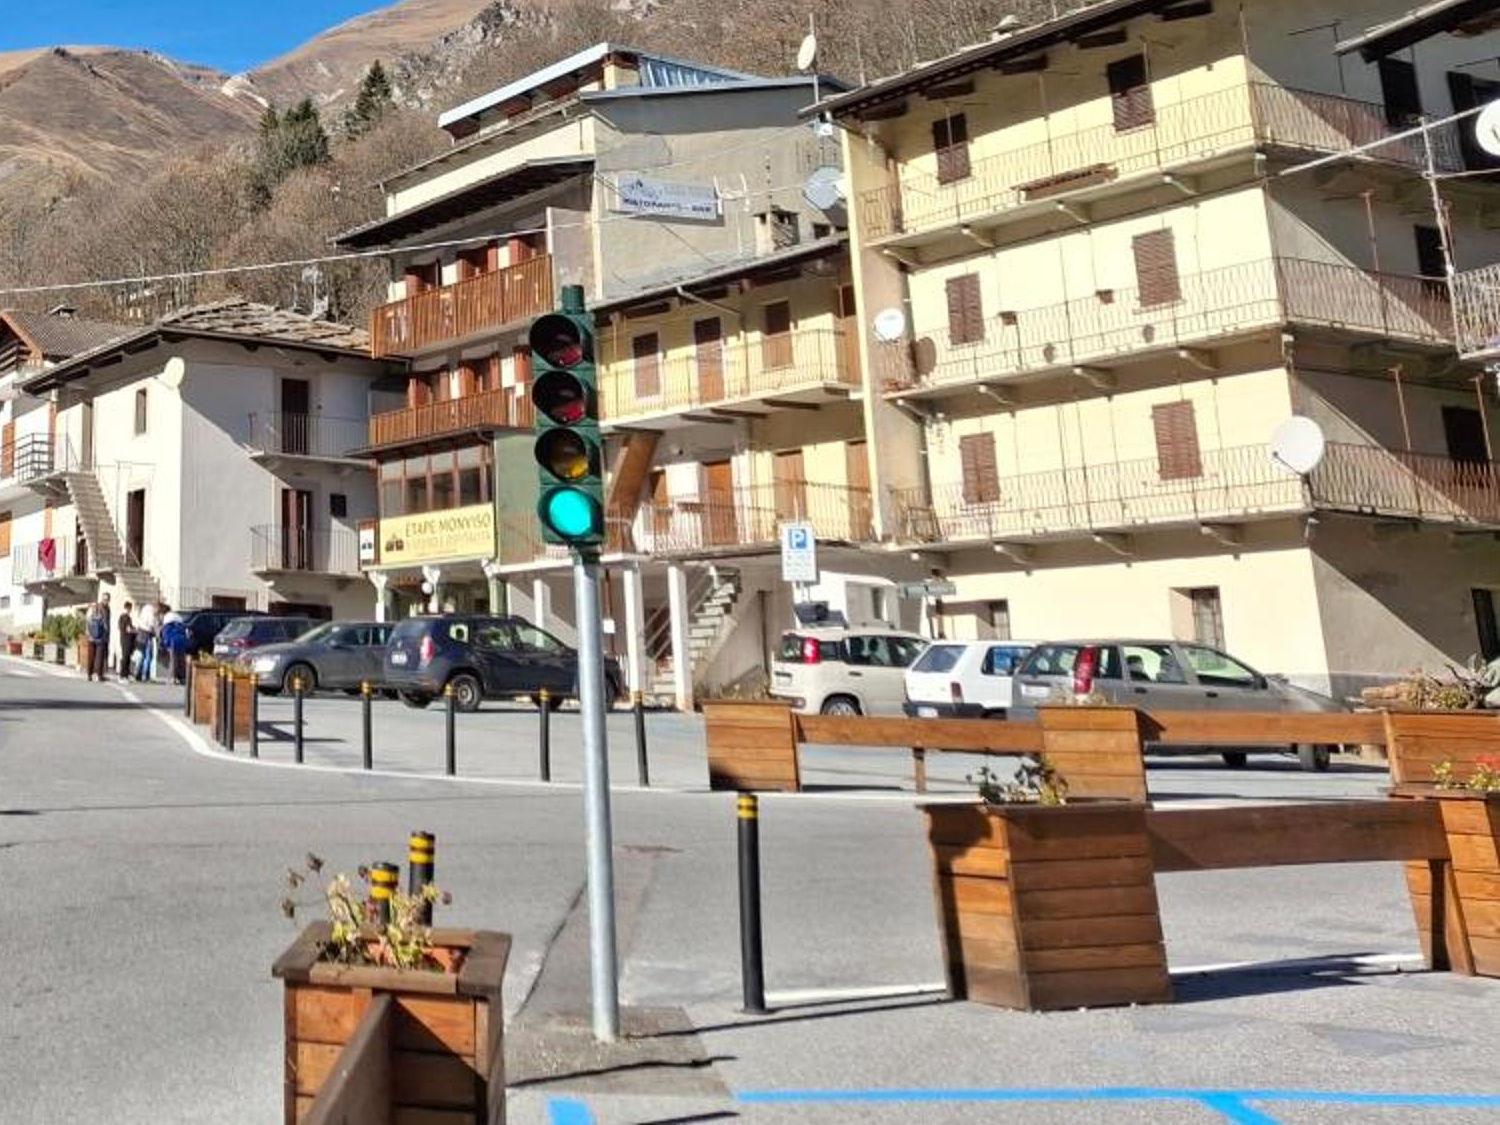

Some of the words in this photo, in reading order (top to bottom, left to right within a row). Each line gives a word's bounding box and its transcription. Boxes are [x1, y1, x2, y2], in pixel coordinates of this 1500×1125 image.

[405, 518, 436, 537] ETAPE
[438, 512, 491, 531] MONVISO
[791, 530, 804, 548] P
